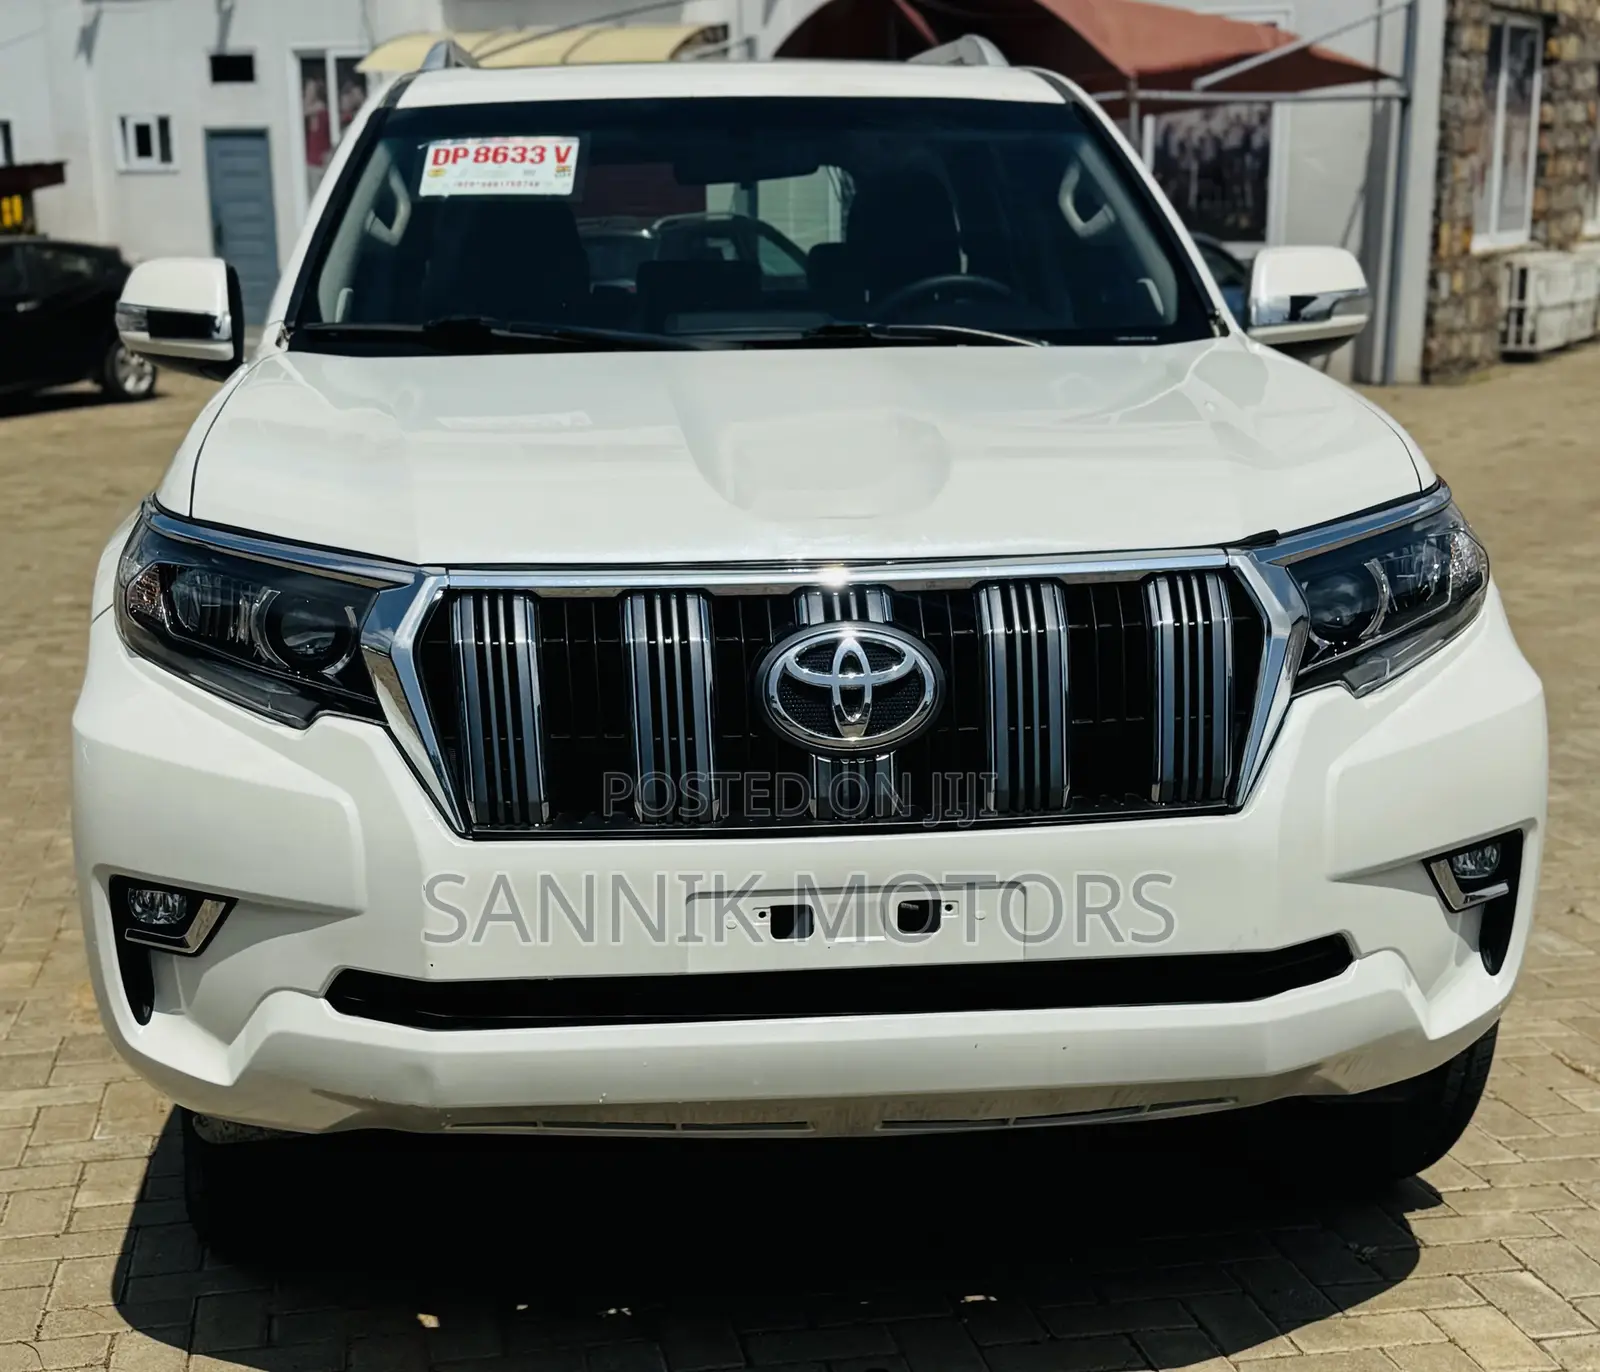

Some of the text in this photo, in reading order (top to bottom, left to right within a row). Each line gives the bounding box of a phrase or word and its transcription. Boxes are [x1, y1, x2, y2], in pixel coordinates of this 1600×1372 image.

[433, 146, 572, 166] DP 8633 V
